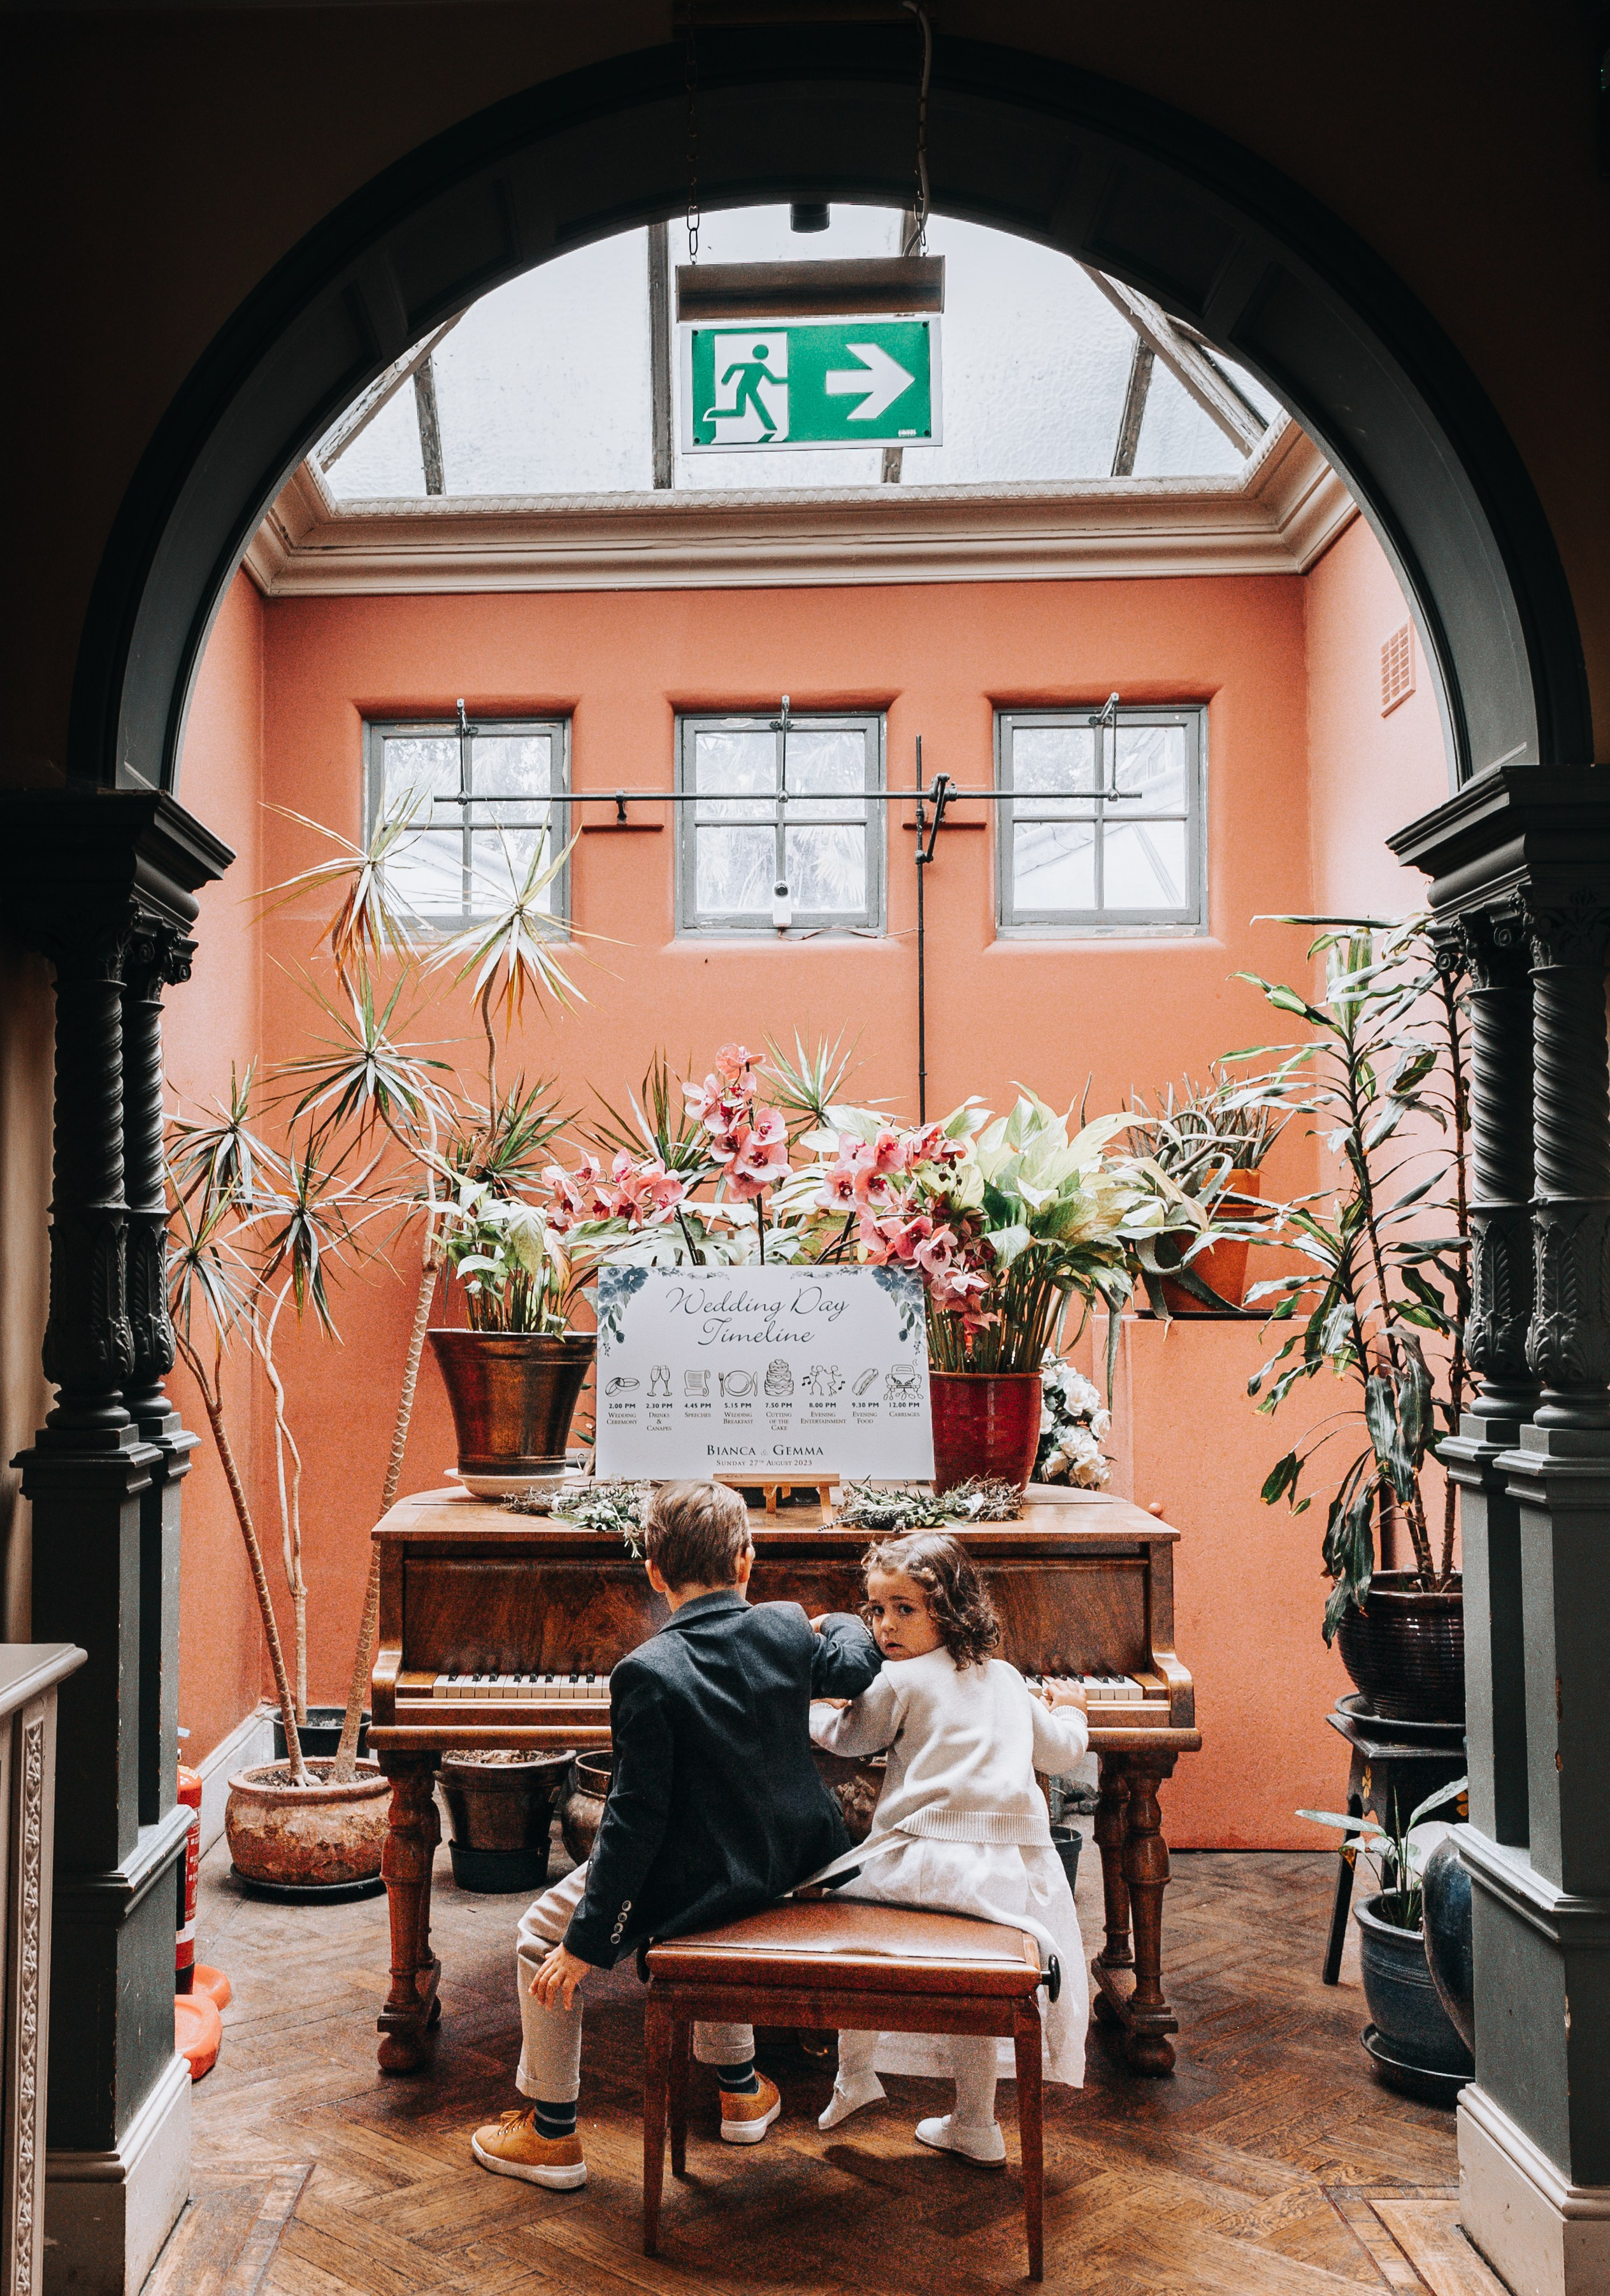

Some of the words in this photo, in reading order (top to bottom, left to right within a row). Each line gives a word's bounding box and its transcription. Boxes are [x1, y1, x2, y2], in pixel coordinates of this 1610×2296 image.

[666, 1287, 785, 1322] Wedding
[790, 1286, 849, 1321] Day
[698, 1317, 815, 1345] Timeline
[707, 1444, 756, 1456] BIANCA
[773, 1444, 824, 1456] GEMMA
